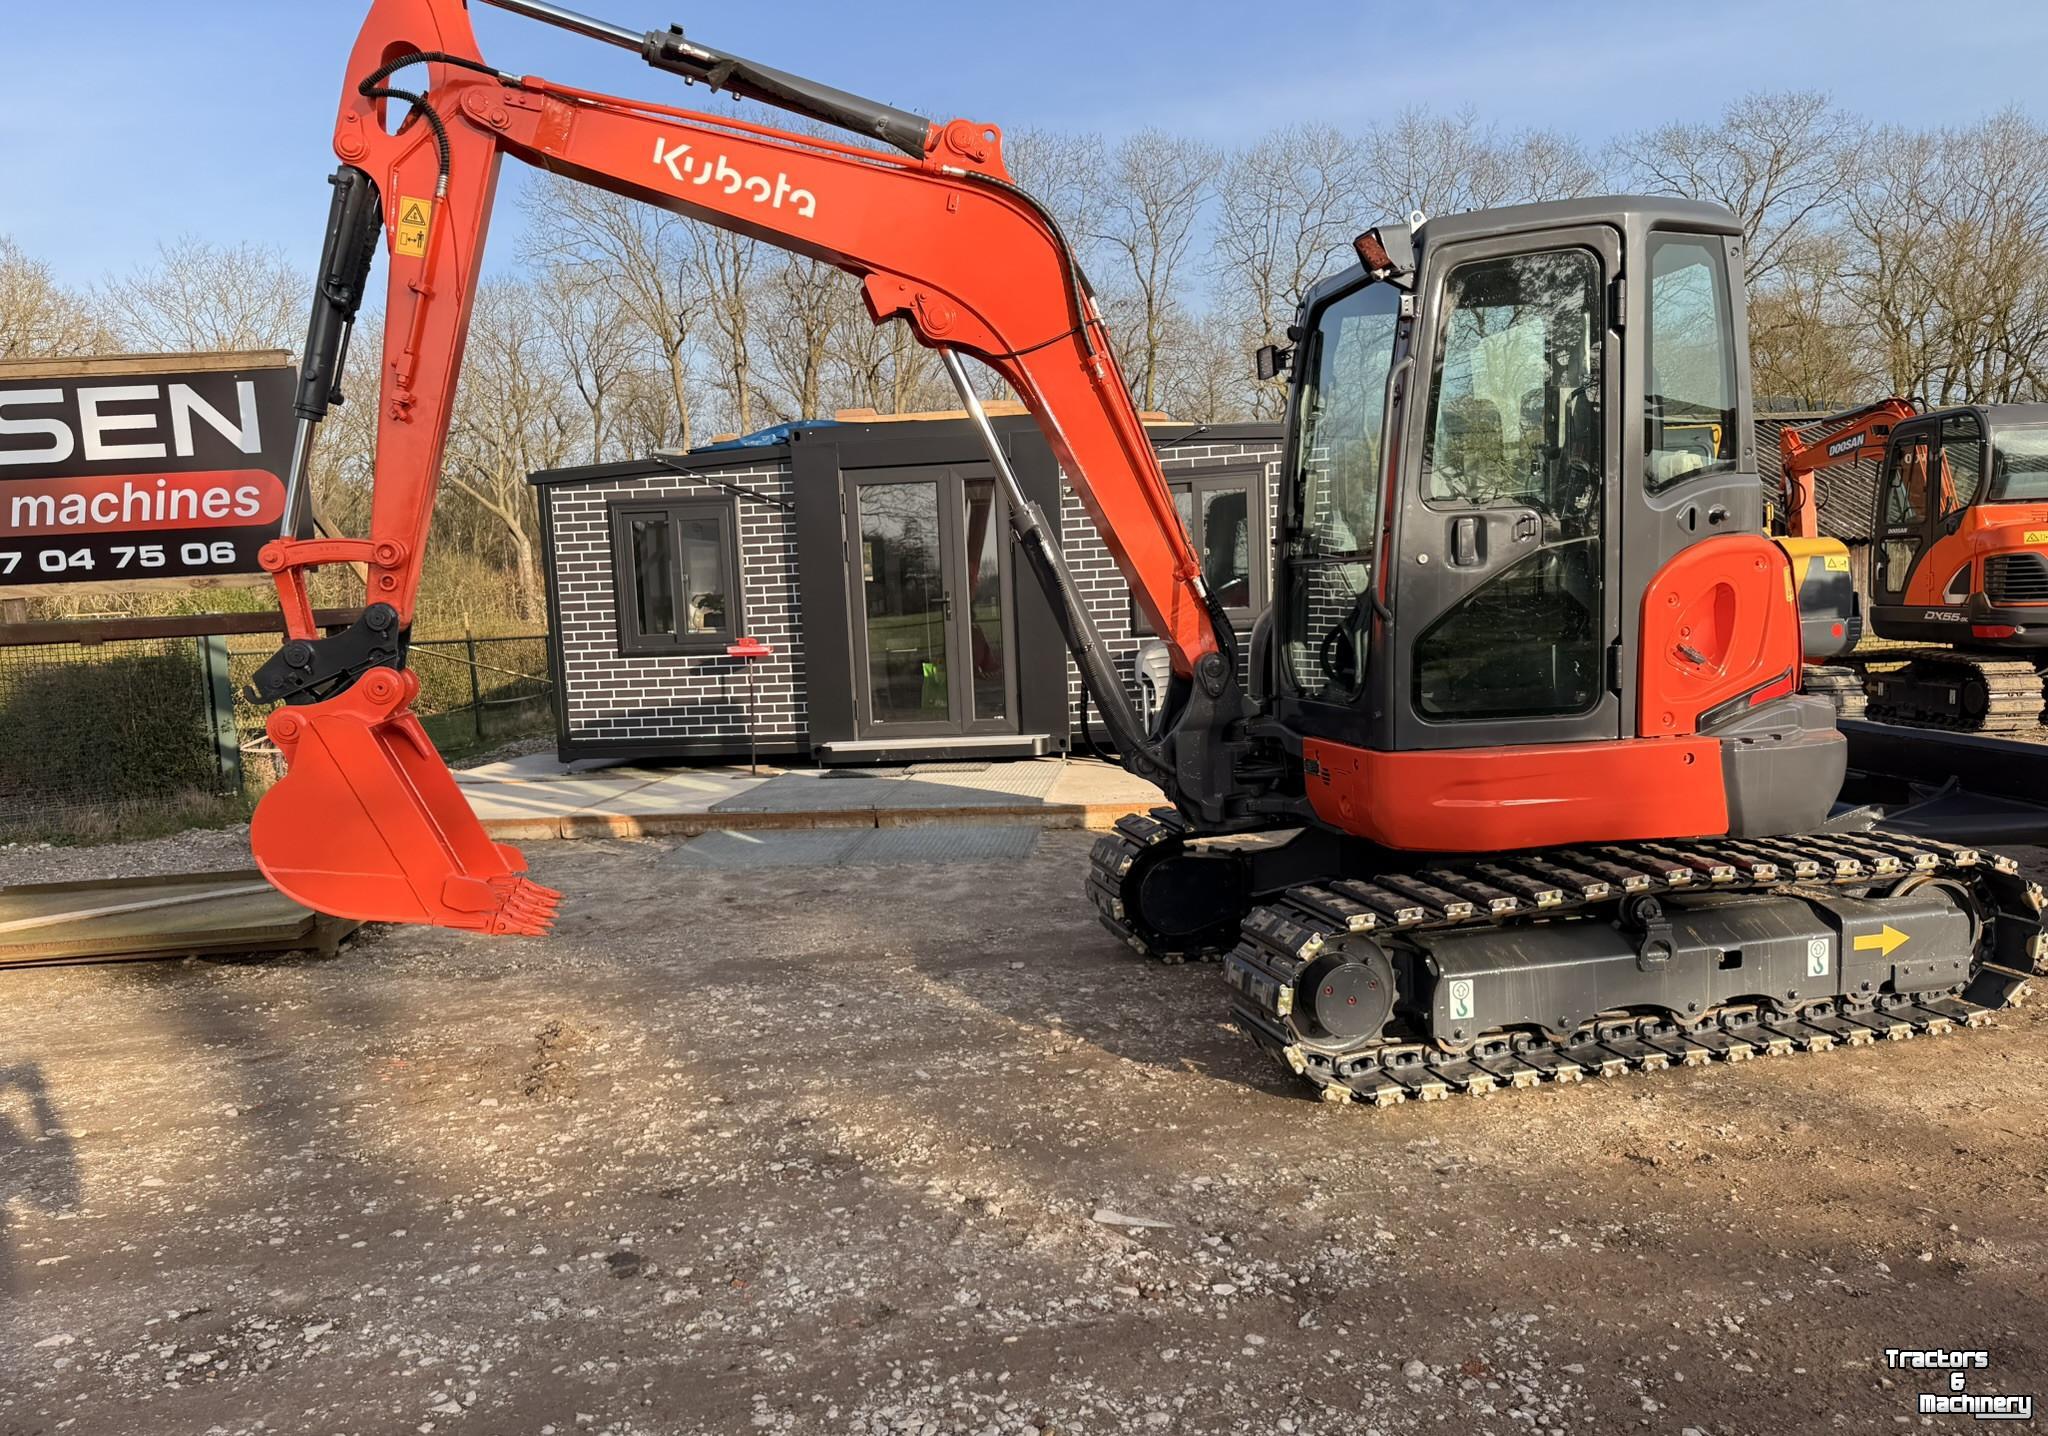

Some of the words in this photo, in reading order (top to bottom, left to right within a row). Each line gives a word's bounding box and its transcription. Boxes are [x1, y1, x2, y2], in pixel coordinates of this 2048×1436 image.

[652, 136, 817, 218] Kubota
[0, 381, 262, 465] SEN
[1829, 433, 1865, 456] DOOSAN
[11, 479, 261, 527] machines
[0, 552, 22, 574] 7
[39, 549, 95, 572] 04
[110, 545, 166, 568] 75
[181, 542, 236, 564] 06
